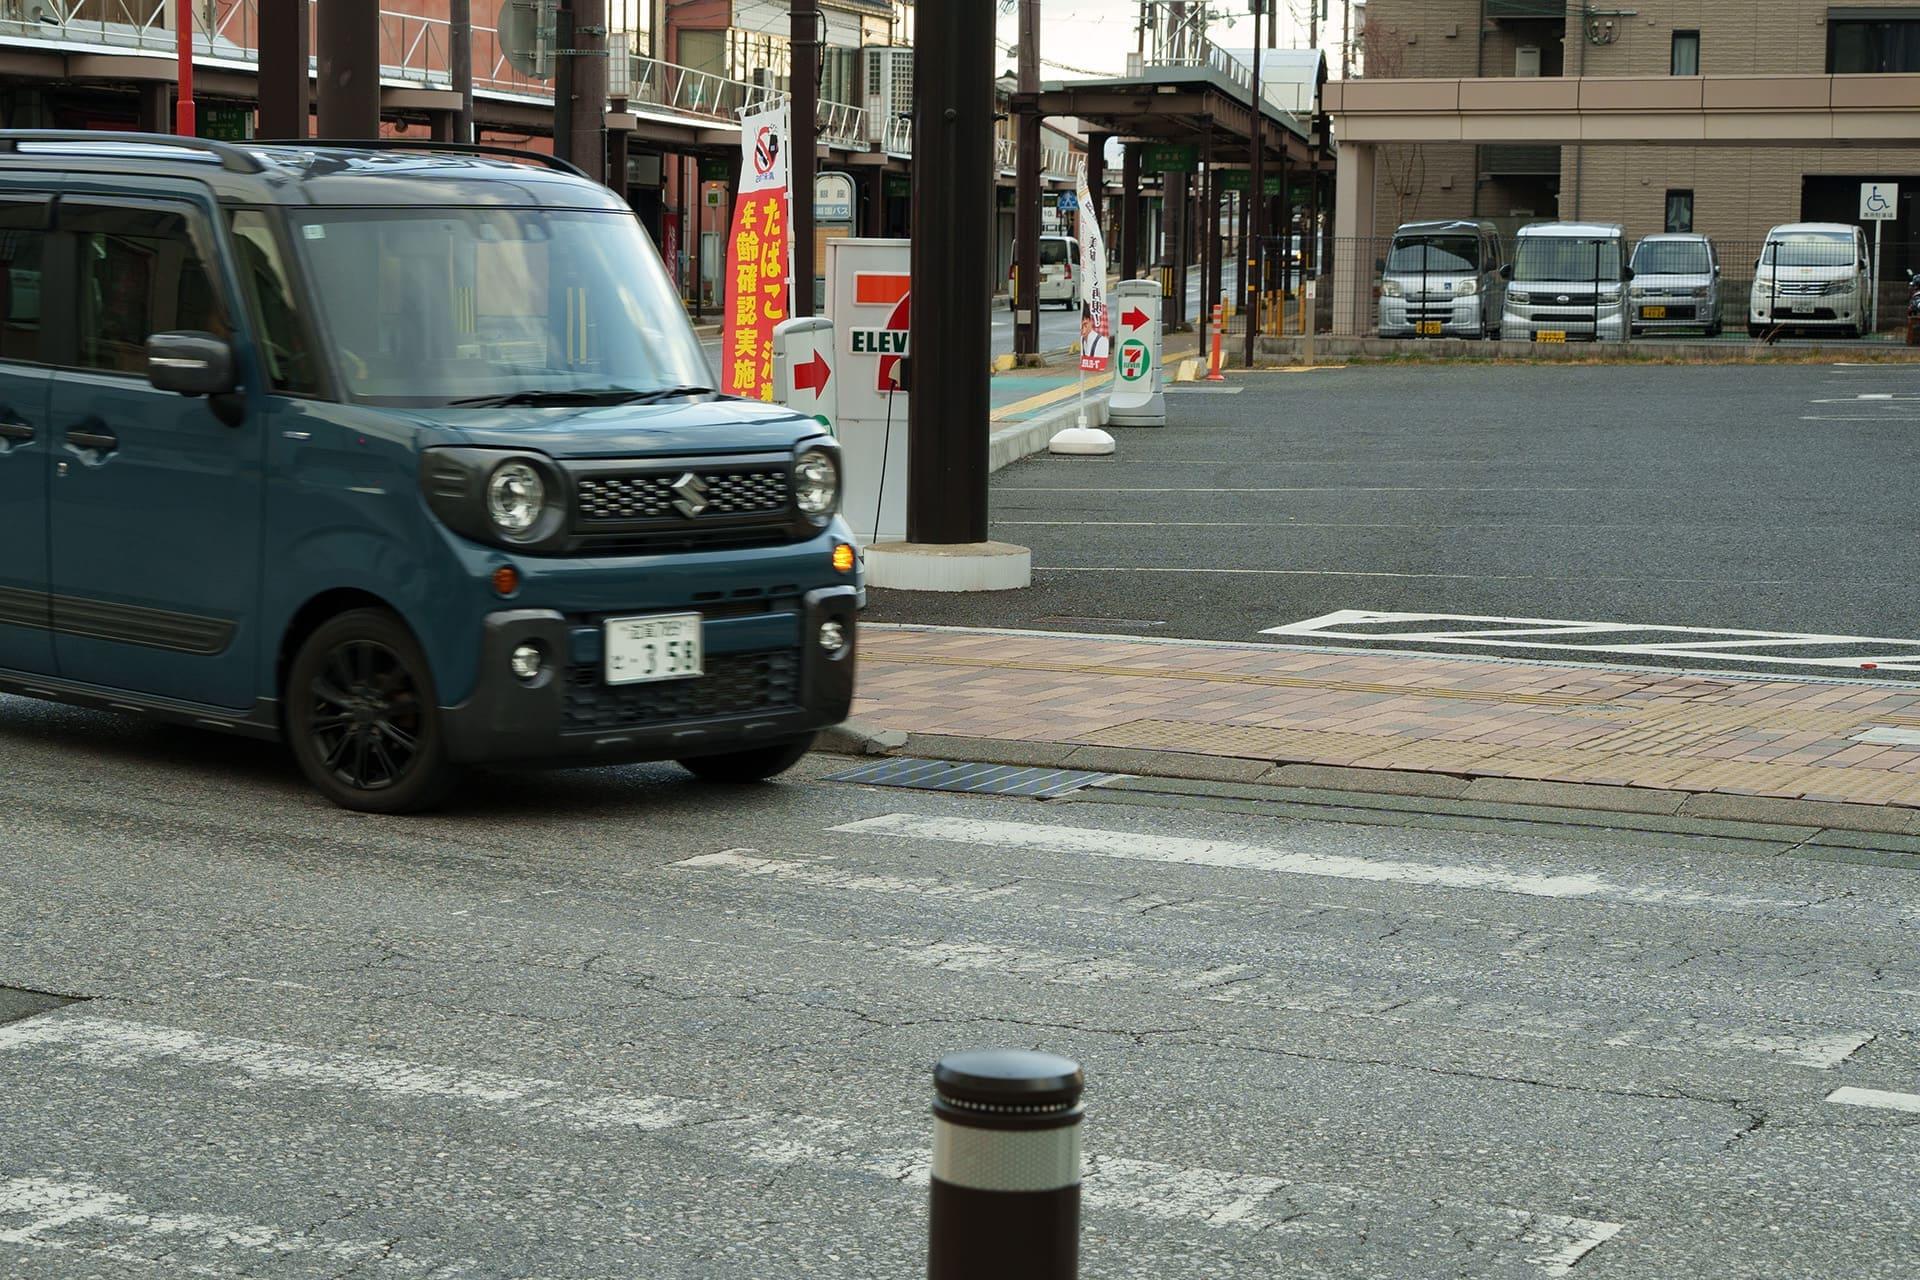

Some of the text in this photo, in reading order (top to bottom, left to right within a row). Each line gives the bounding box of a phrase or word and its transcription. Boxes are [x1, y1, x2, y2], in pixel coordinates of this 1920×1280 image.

[733, 201, 760, 399] 年齢確認実施
[760, 198, 784, 320] たばこ
[852, 331, 908, 353] ELEV
